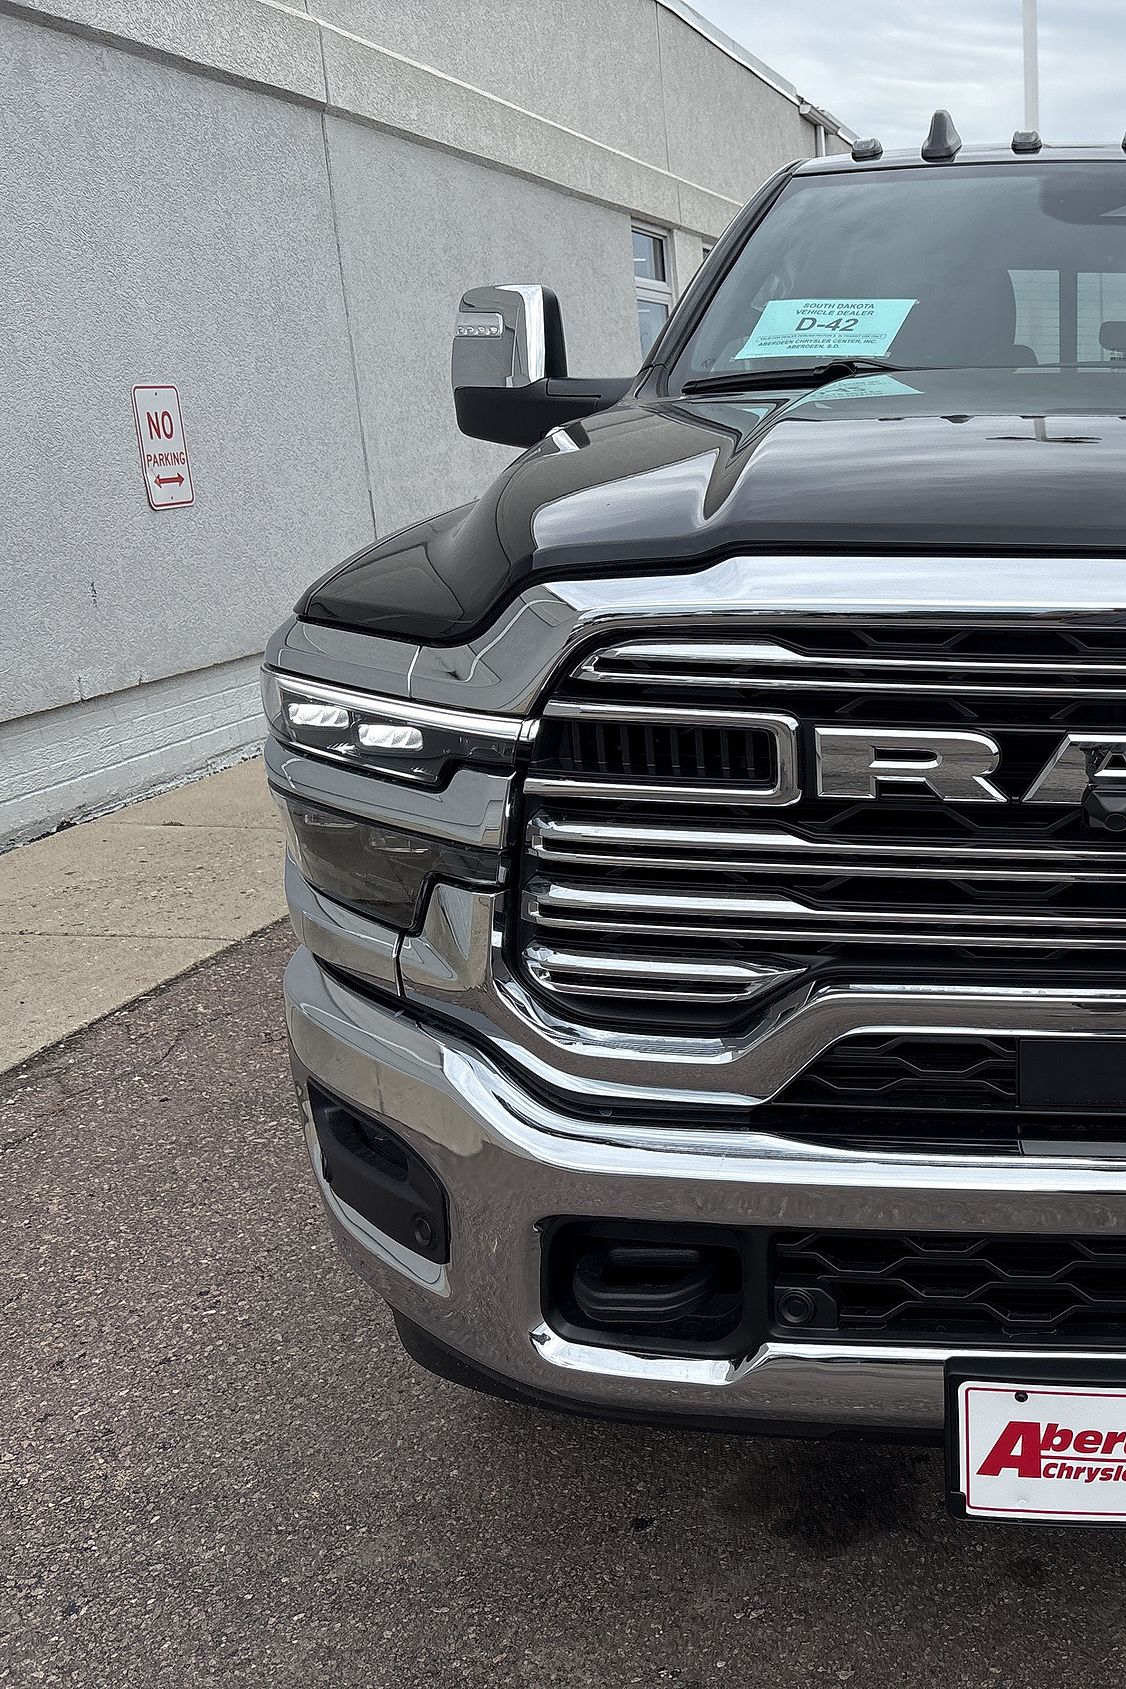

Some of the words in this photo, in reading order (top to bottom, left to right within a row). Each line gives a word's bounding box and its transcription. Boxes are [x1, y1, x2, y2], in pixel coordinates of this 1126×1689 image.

[795, 317, 859, 332] D-42
[757, 339, 794, 347] ABERDEEN
[146, 410, 174, 440] NO
[146, 451, 186, 468] PARKING
